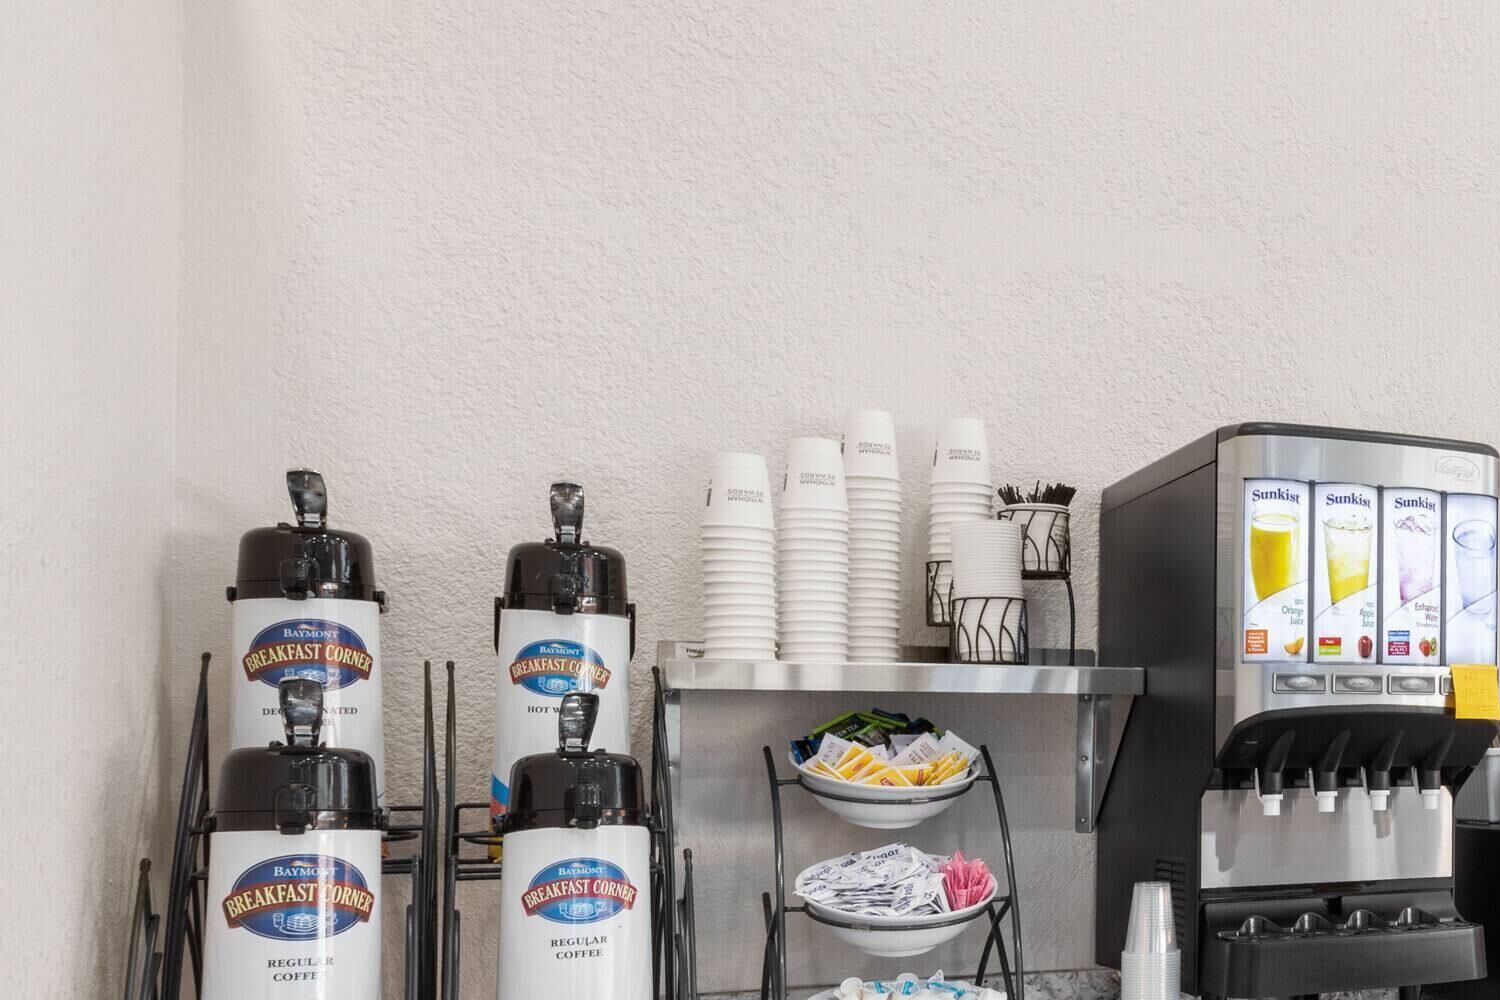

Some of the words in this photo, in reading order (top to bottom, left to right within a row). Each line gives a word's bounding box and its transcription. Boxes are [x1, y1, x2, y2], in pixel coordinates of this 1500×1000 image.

[1252, 488, 1300, 506] Sunkist
[1326, 493, 1371, 509] Sunkist
[1394, 496, 1436, 513] Sunkist
[1281, 606, 1304, 617] Orange
[1359, 608, 1375, 619] Apple
[1289, 617, 1304, 625] Juice
[1361, 618, 1375, 628] Juice
[283, 628, 340, 639] BAYMONT
[540, 646, 581, 656] BAYMONT
[245, 643, 322, 673] BREAKFAST
[325, 644, 372, 673] CORNER
[511, 658, 567, 678] BREAKFAST
[527, 705, 551, 713] HOT
[558, 866, 604, 876] BAYMONT
[524, 879, 589, 909] BREAKFAST
[593, 879, 635, 903] CORNER
[225, 883, 317, 918] BREAKFAST
[323, 883, 373, 913] CORNER
[551, 935, 608, 947] REGULAR
[556, 949, 604, 960] COFFEE
[267, 957, 334, 968] REGULR
[273, 972, 327, 982] COFFE
